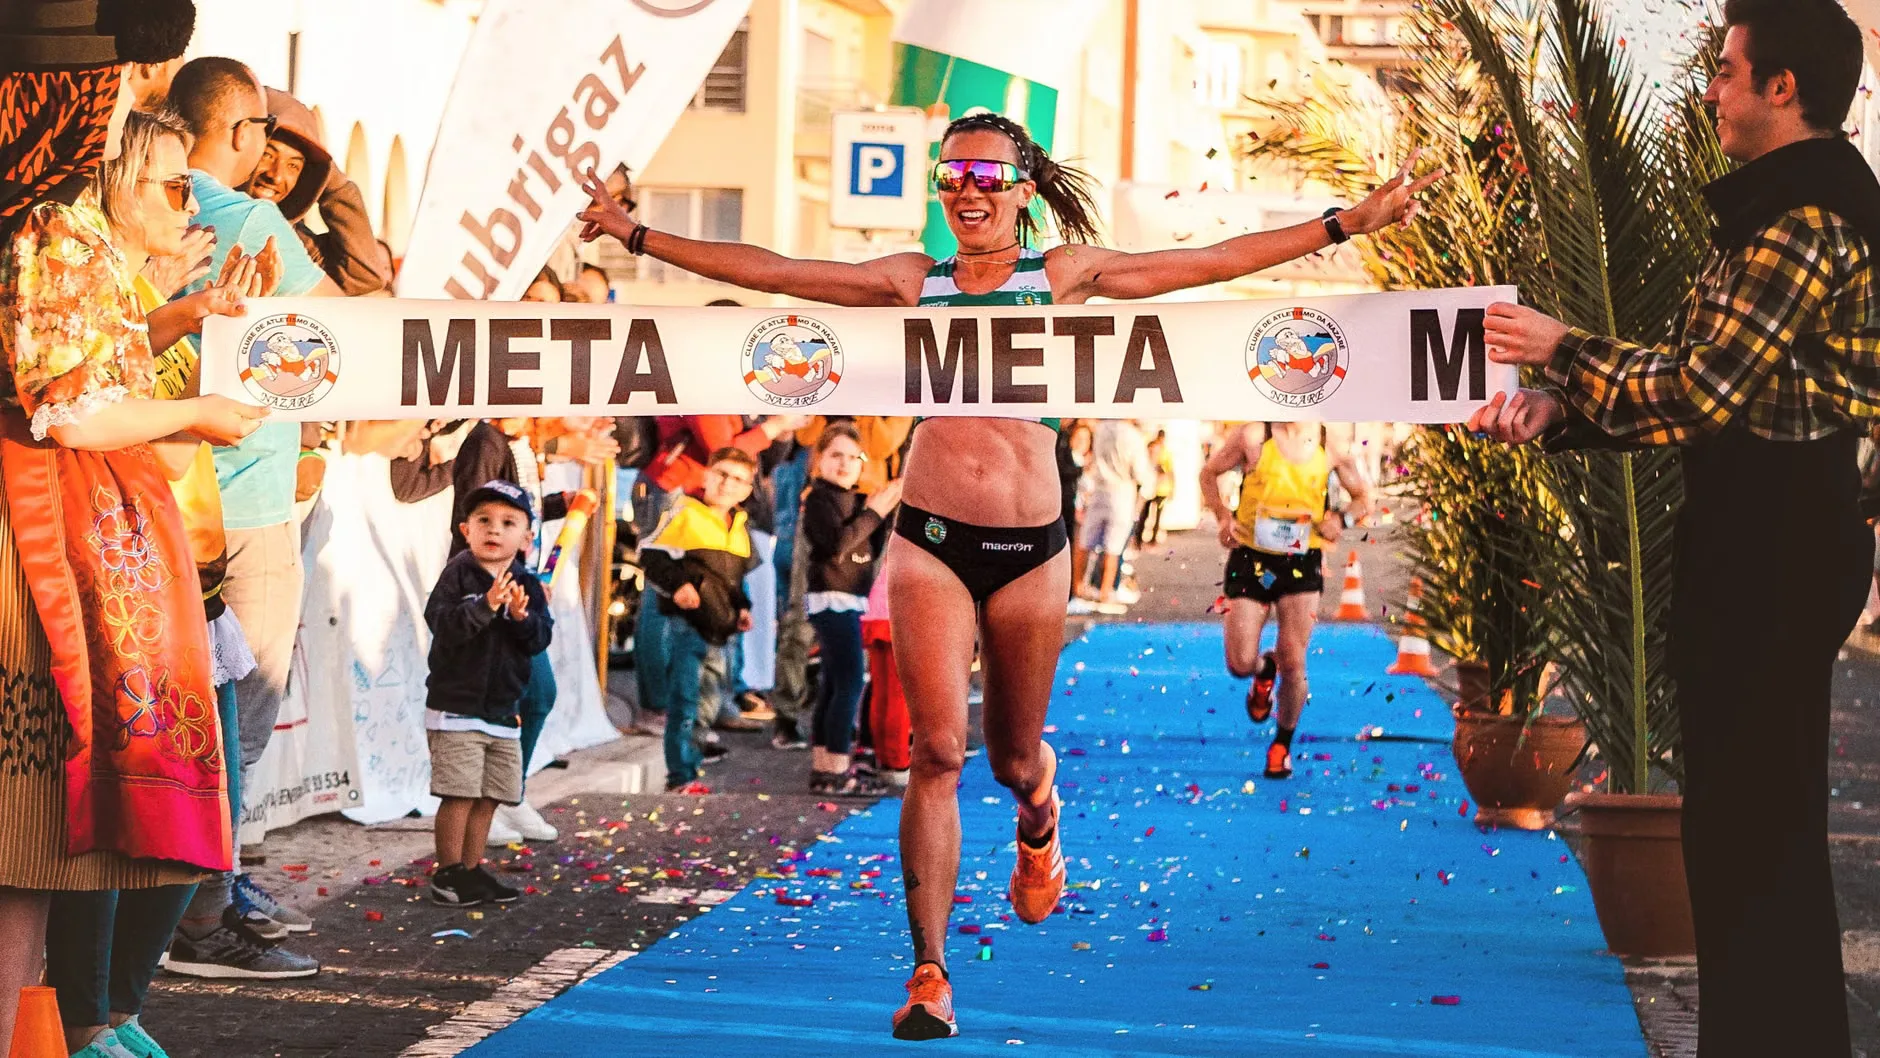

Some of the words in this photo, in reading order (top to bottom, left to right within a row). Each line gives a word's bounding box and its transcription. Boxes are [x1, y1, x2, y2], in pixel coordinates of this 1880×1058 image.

[858, 146, 896, 194] P
[241, 332, 256, 355] CLUBE
[255, 323, 265, 333] DE
[266, 317, 309, 326] ATLETISMO
[309, 322, 319, 331] DA
[745, 333, 759, 357] CLUBE
[757, 324, 767, 334] DE
[768, 318, 809, 327] ATLETISMO
[811, 322, 821, 330] DA
[1249, 327, 1263, 352] CLUBE
[1262, 319, 1271, 328] DE
[1273, 311, 1315, 321] ATLETISMO
[1316, 315, 1326, 324] DA
[401, 319, 678, 406] META
[904, 315, 1184, 403] META
[1410, 308, 1486, 401] M
[261, 390, 315, 409] NAZARÉ
[764, 389, 819, 407] NAZARÉ
[1270, 385, 1325, 406] NAZARÉ
[982, 541, 1034, 552] macron
